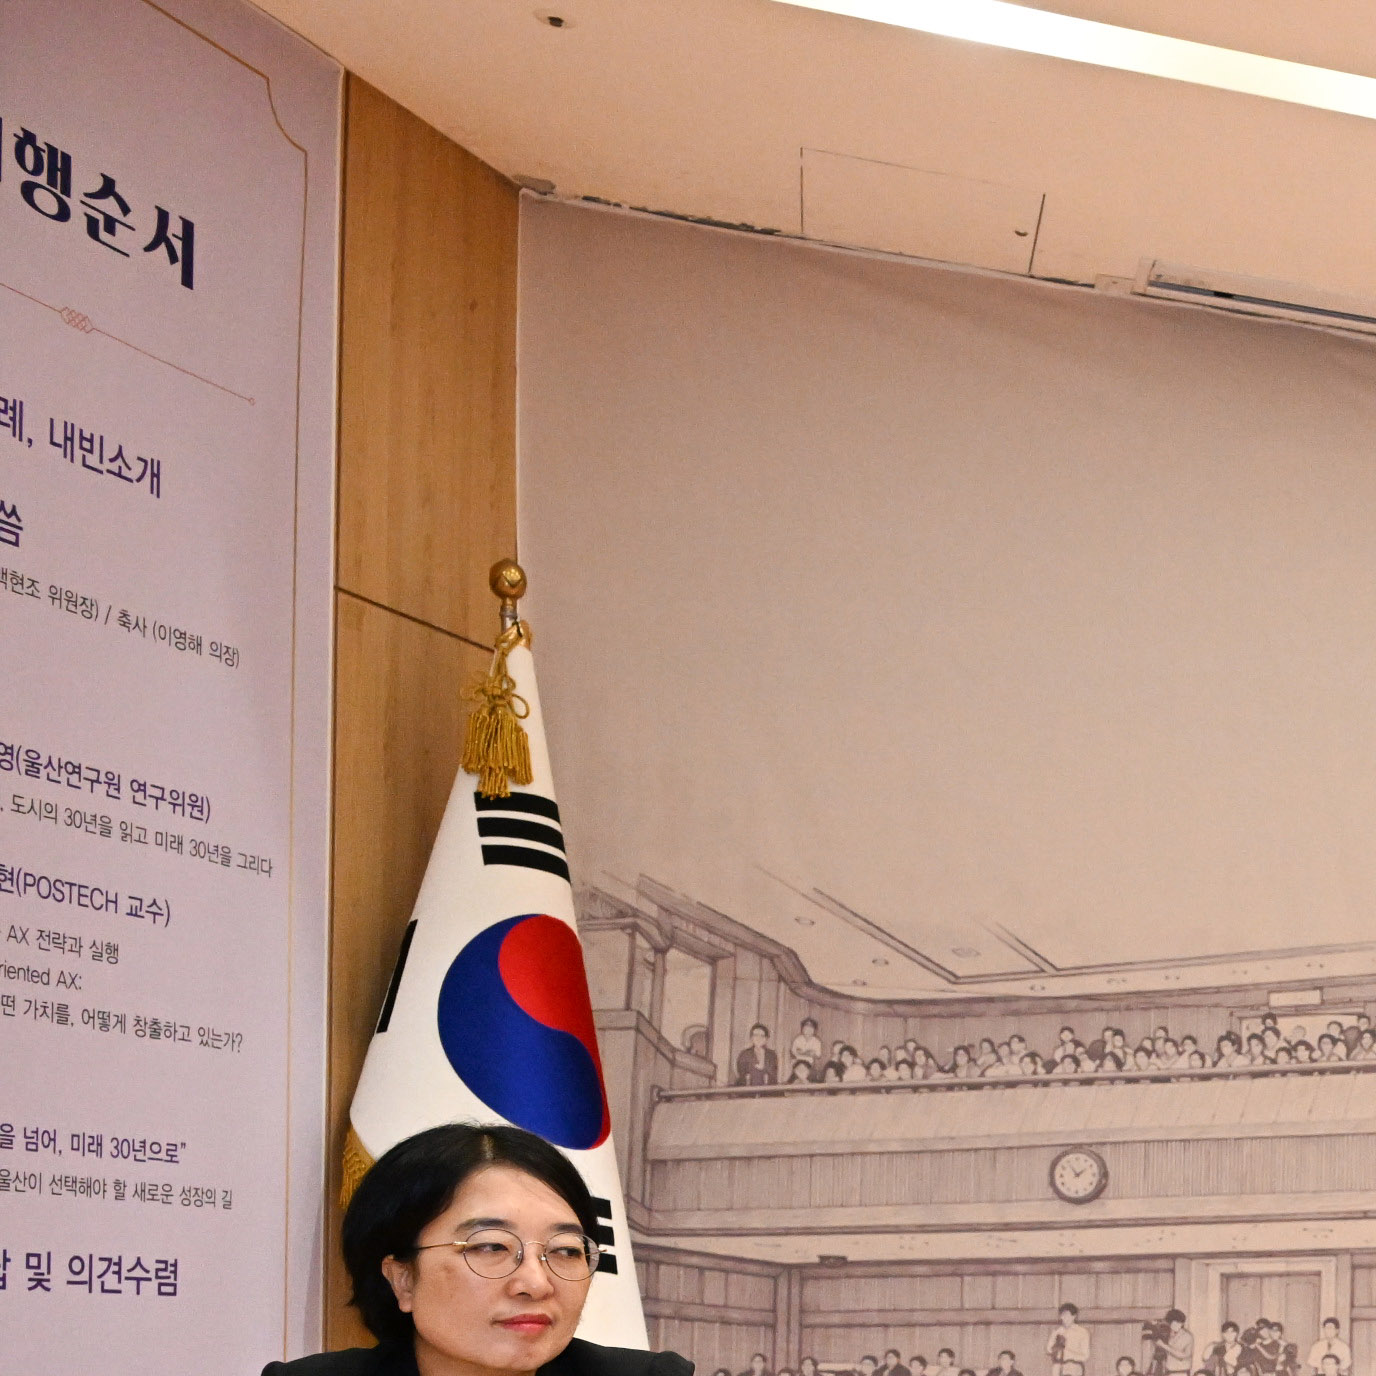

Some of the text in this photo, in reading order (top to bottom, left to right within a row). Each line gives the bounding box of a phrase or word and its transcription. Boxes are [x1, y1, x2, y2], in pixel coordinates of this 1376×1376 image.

[0, 117, 195, 290] 행순서
[49, 417, 161, 499] 내빈소개
[47, 584, 100, 621] 위원장)
[117, 609, 147, 638] 축사
[153, 620, 203, 656] (이영해
[209, 641, 241, 669] 의장)
[130, 778, 211, 824] 연구위원)
[11, 793, 273, 878] 도시의 30년을 읽고 미래 30년을 그리다
[126, 895, 171, 928] 교수)
[7, 925, 120, 964] AX 전략과 실행
[56, 970, 83, 991] AX:
[23, 999, 75, 1028] 가치를,
[81, 1008, 126, 1034] 어떻게
[133, 1015, 192, 1043] 창출하고
[197, 1026, 243, 1053] 있는가?
[23, 1127, 62, 1157] 넘어,
[71, 1132, 103, 1158] 미래
[110, 1137, 187, 1164] 30년으로"
[0, 1168, 233, 1210] 울산이 선택해야 할 새로운 성장의 길
[25, 1251, 51, 1292] 및
[66, 1253, 179, 1297] 의견수렴
